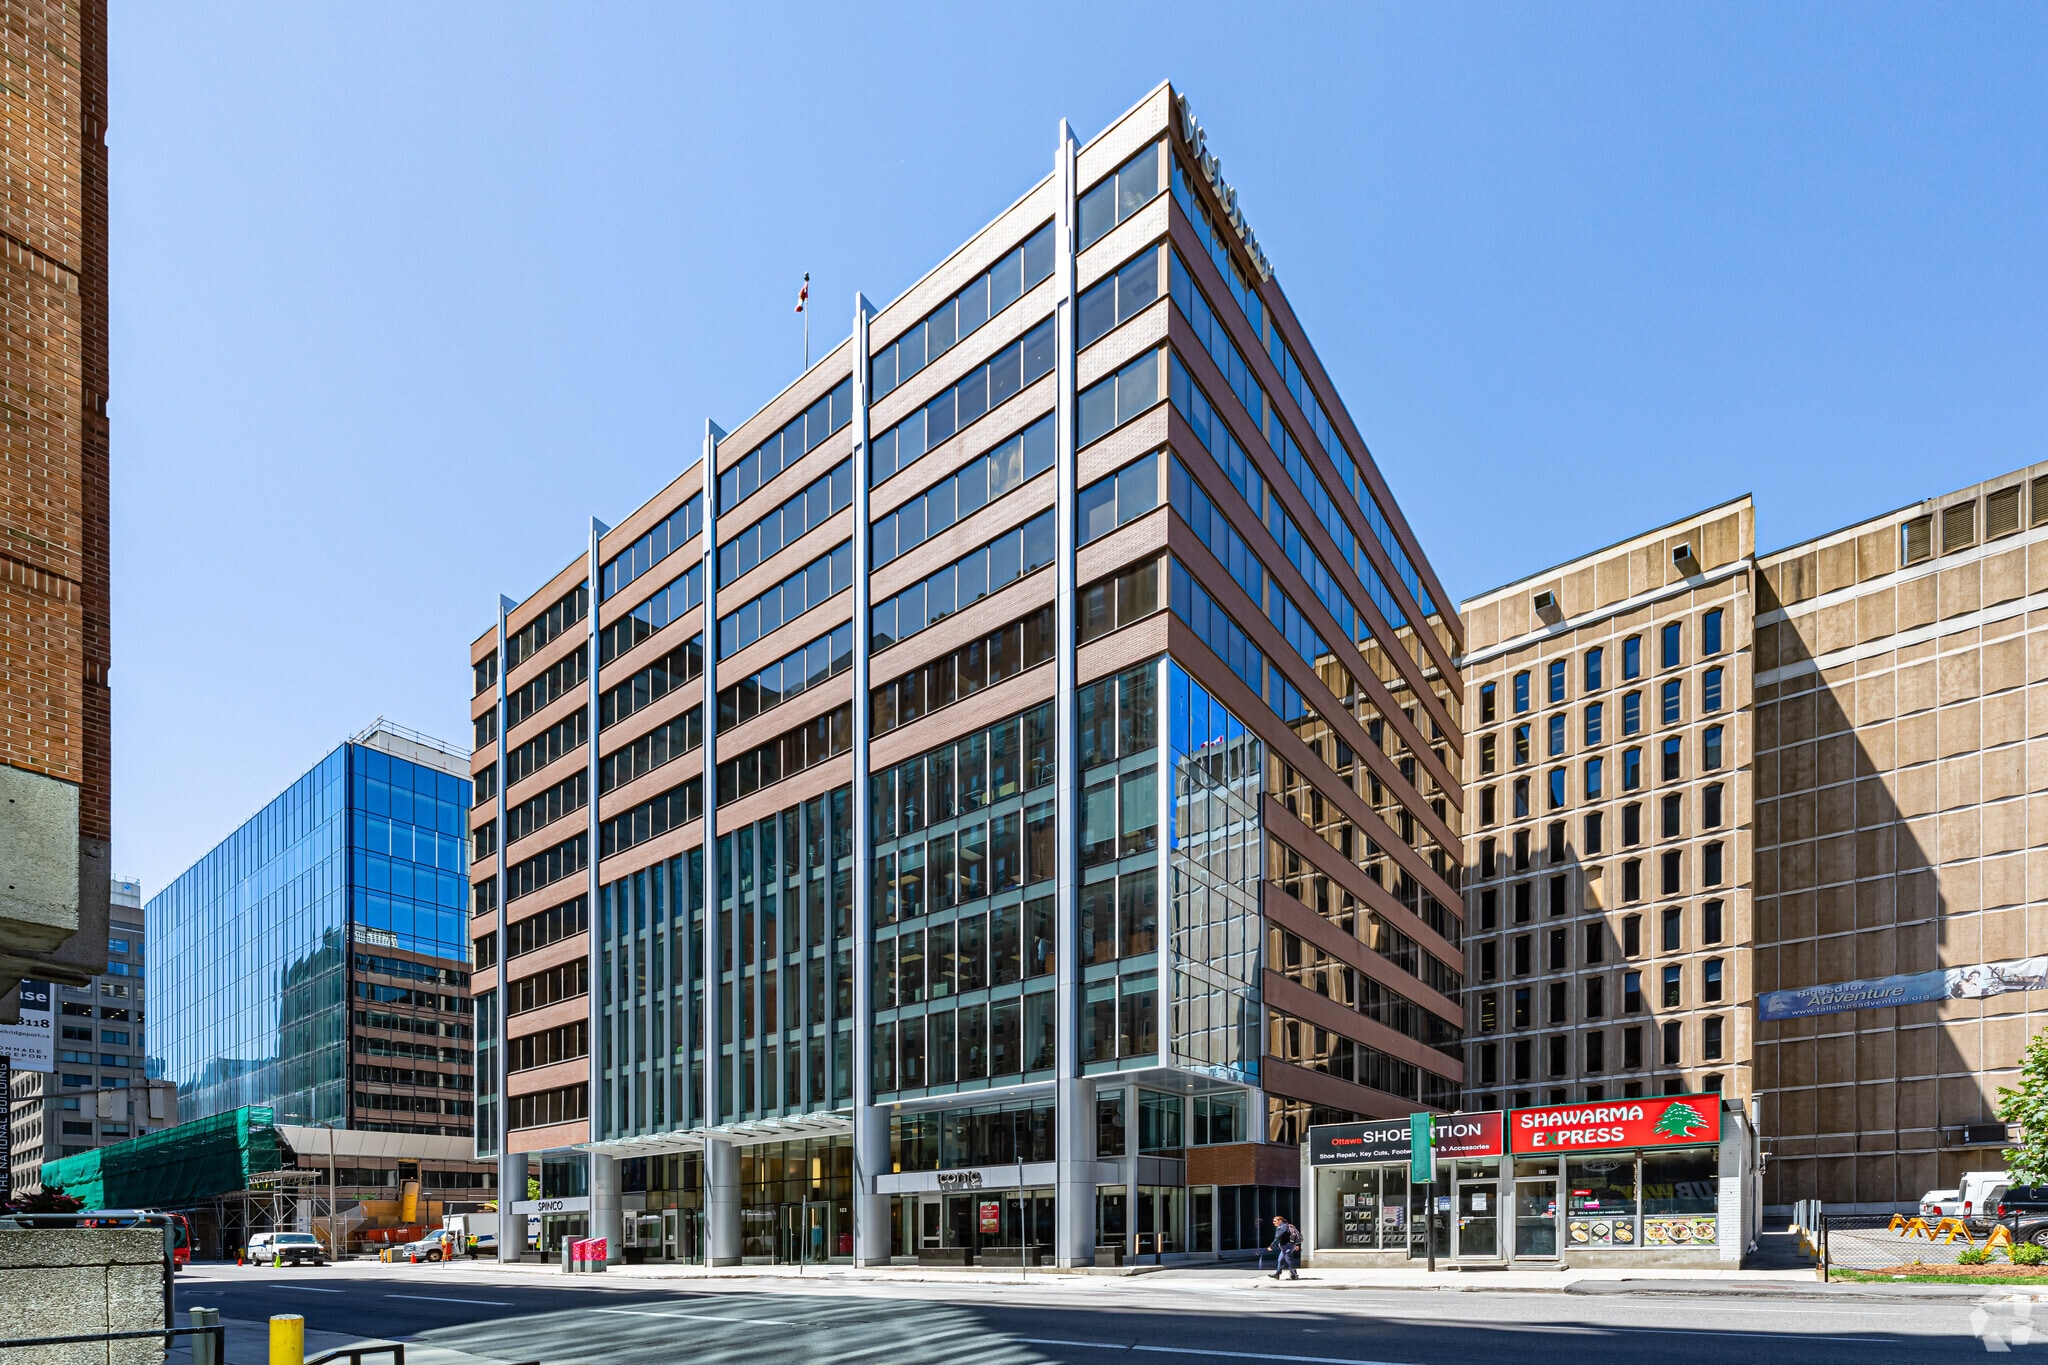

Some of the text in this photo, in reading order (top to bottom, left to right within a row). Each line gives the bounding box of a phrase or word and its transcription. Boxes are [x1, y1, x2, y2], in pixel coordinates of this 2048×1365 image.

[1797, 983, 1866, 998] Rigged for
[1807, 987, 1905, 1006] Adventure
[1791, 994, 1930, 1015] www.tallshipsadventure.org
[1520, 1105, 1644, 1129] SHAWARMA
[0, 1063, 8, 1193] THE NATIONAL BUILDING
[1532, 1126, 1625, 1147] EXPRESS
[1331, 1138, 1363, 1146] Ottawa
[1448, 1143, 1490, 1151] Accessories
[538, 1200, 564, 1212] SPINCO
